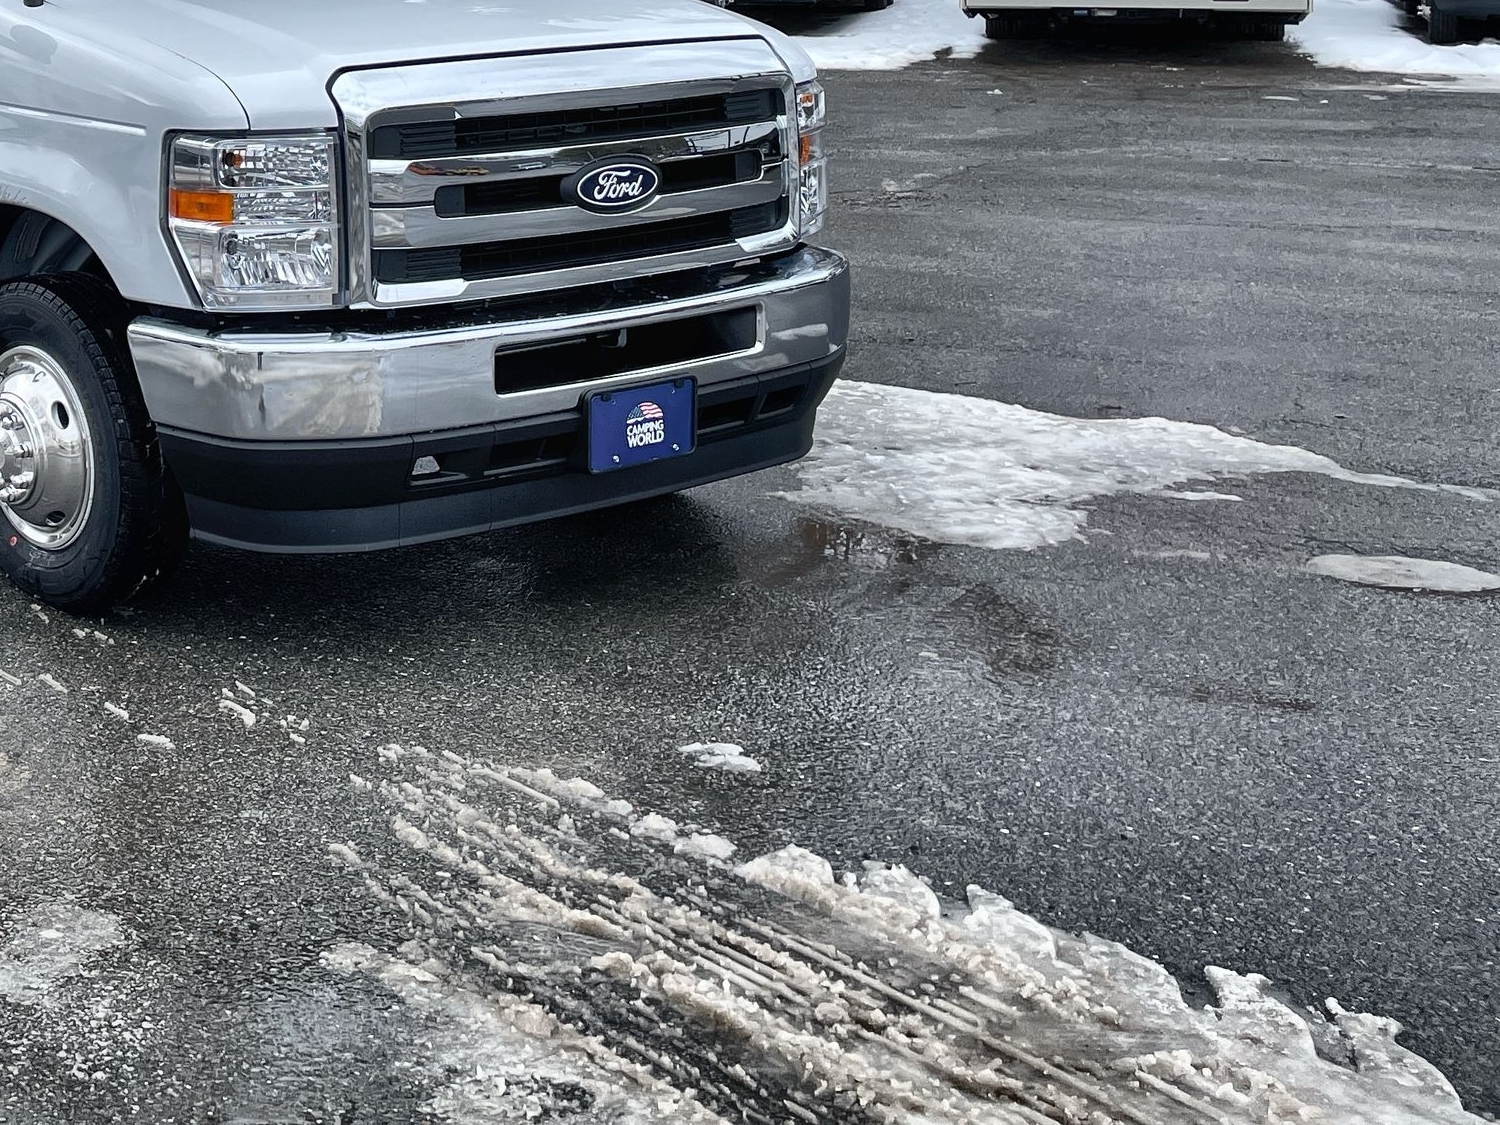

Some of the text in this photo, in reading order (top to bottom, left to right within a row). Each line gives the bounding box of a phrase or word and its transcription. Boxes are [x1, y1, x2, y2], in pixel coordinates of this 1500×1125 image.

[593, 170, 644, 200] Ford
[627, 419, 664, 436] CAMPING
[627, 431, 664, 448] WORLD
